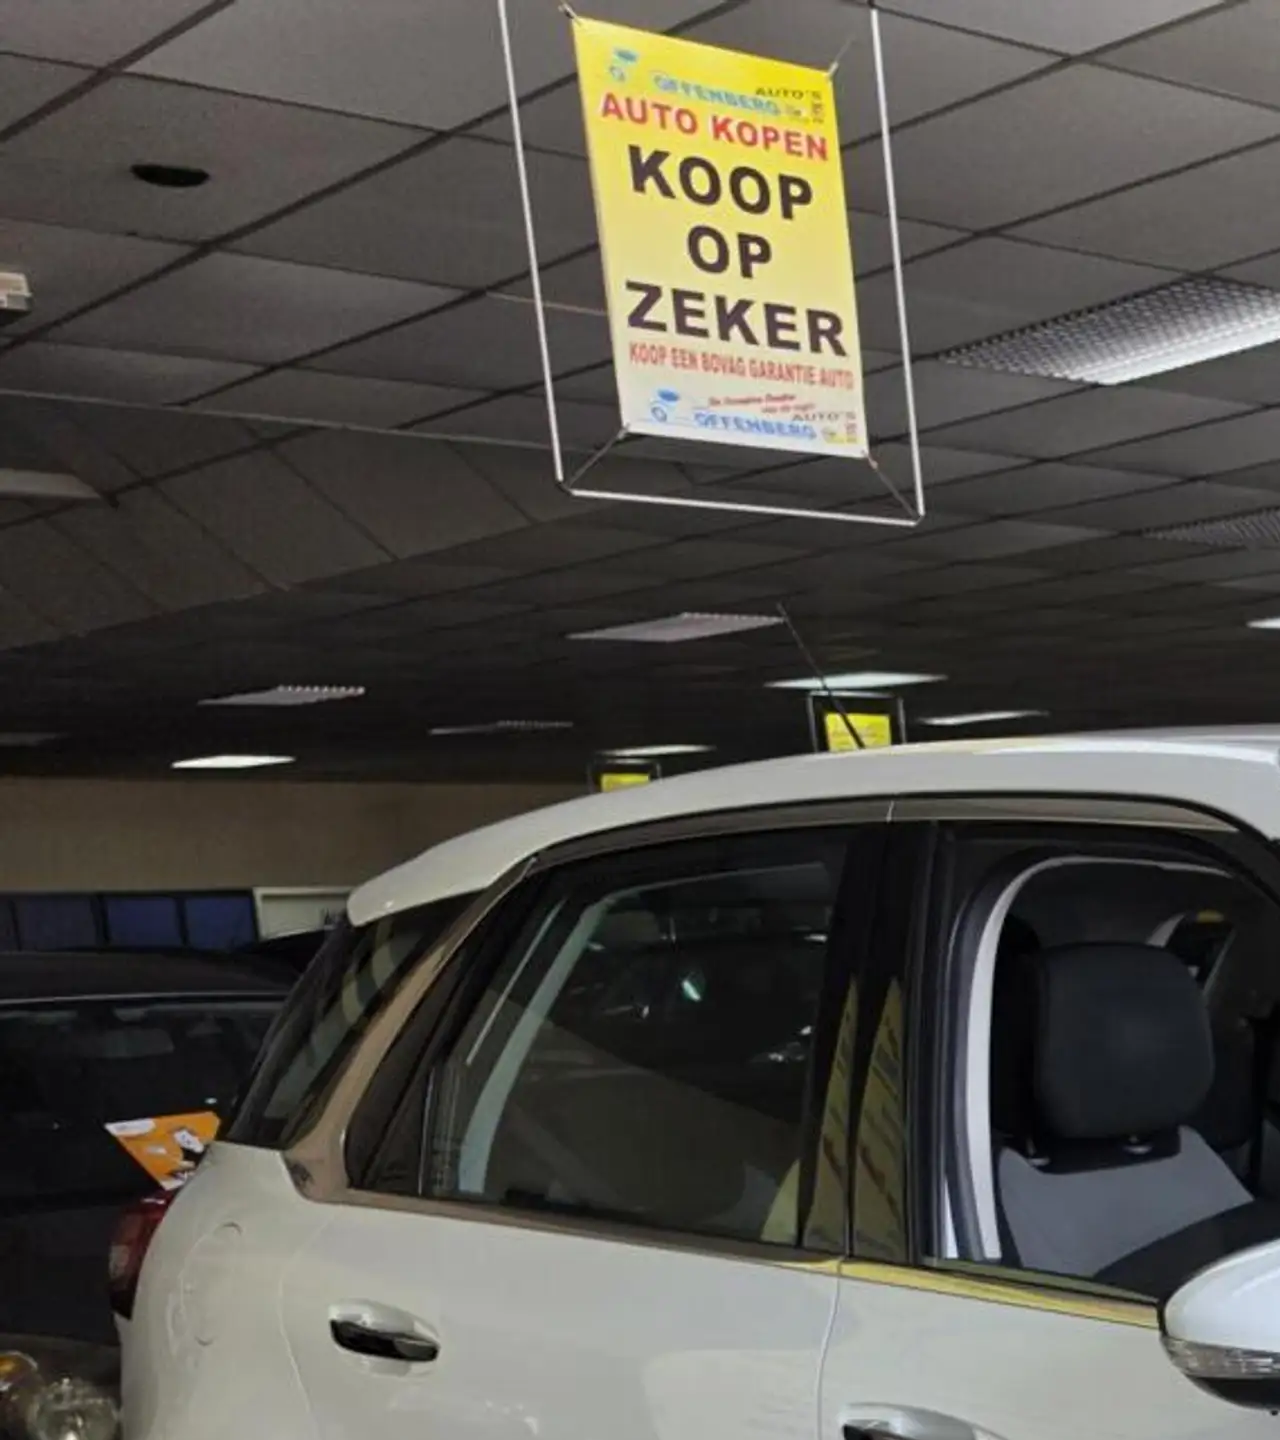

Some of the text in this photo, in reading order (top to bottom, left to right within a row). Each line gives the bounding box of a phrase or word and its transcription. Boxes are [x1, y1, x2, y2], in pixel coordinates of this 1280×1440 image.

[601, 92, 828, 161] AUTO KOPEN
[628, 144, 813, 221] KOOP
[687, 225, 772, 279] OP
[624, 280, 848, 357] ZEKER
[629, 341, 854, 390] KOOP EEN BOVAG GARANTIE AUTO
